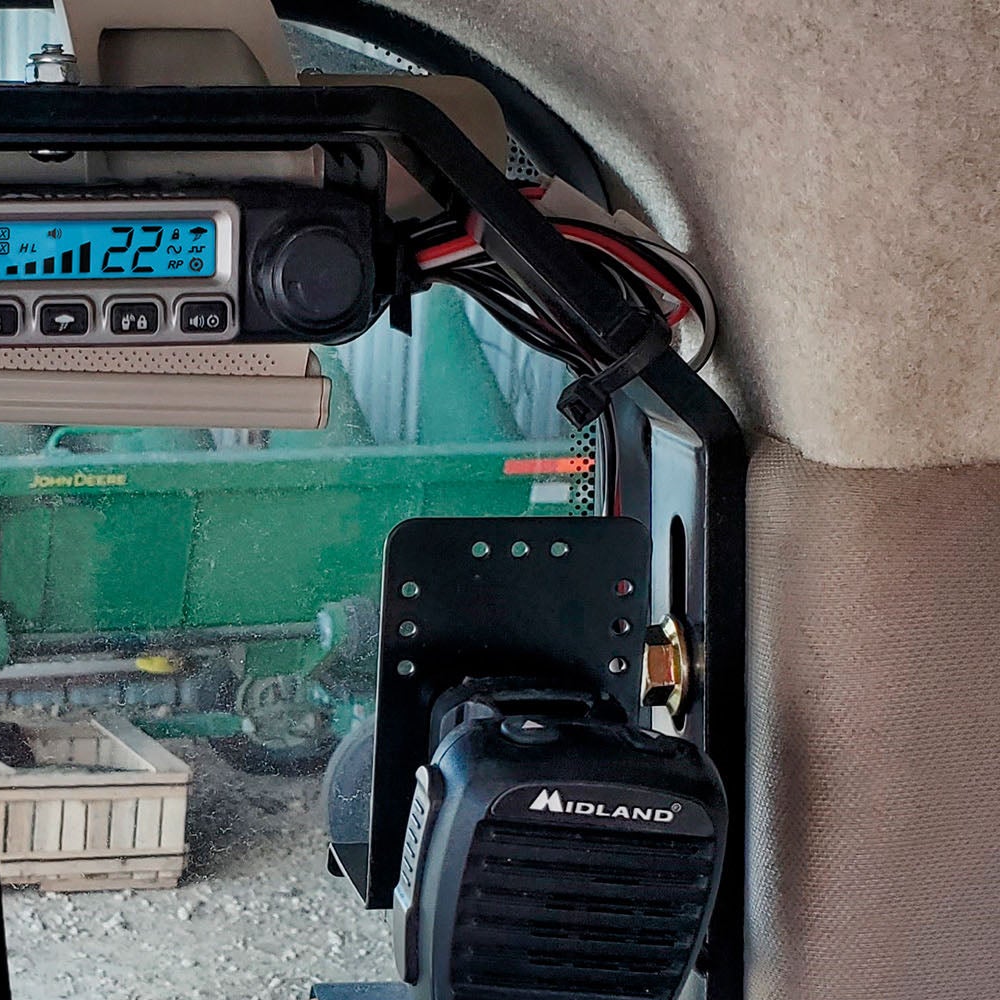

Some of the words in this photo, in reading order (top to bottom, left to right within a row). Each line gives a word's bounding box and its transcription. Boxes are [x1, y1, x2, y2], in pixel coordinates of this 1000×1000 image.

[102, 226, 164, 273] 22
[167, 259, 184, 269] RP
[529, 788, 675, 822] MIDLAND
